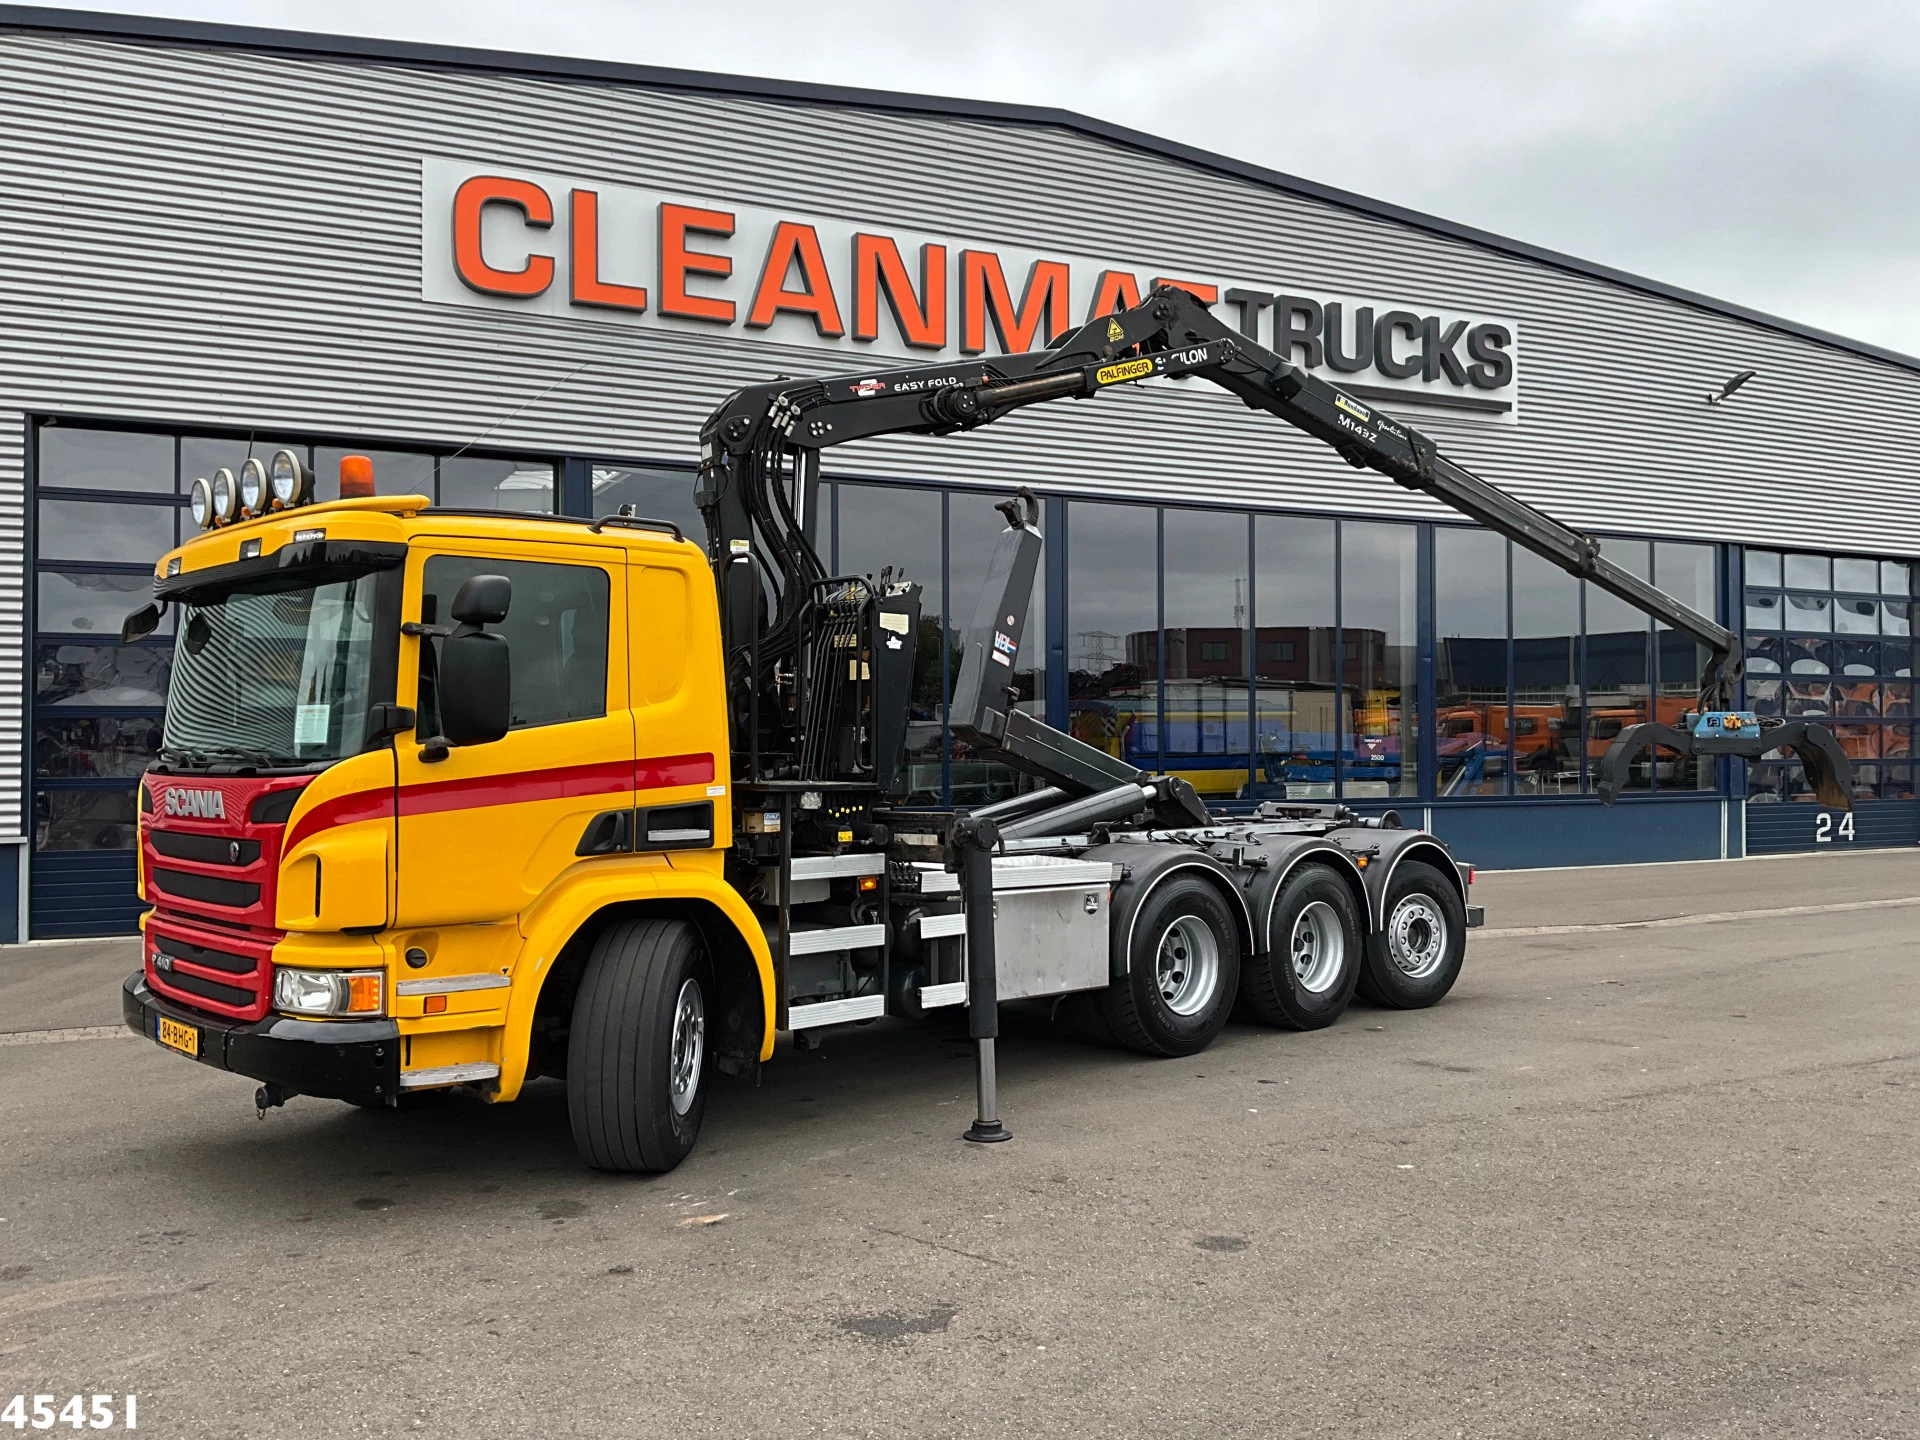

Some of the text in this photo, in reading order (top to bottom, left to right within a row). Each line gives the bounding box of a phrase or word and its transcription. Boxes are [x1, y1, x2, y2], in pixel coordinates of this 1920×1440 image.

[1224, 287, 1513, 390] TRUCKS
[894, 376, 957, 392] EASY FOLD
[1099, 361, 1150, 381] PALFINGER
[1338, 413, 1378, 443] M143Z
[165, 787, 226, 820] SCANIA
[1815, 811, 1856, 843] 24
[156, 956, 170, 971] 410
[162, 1021, 196, 1051] 84-BHG-1
